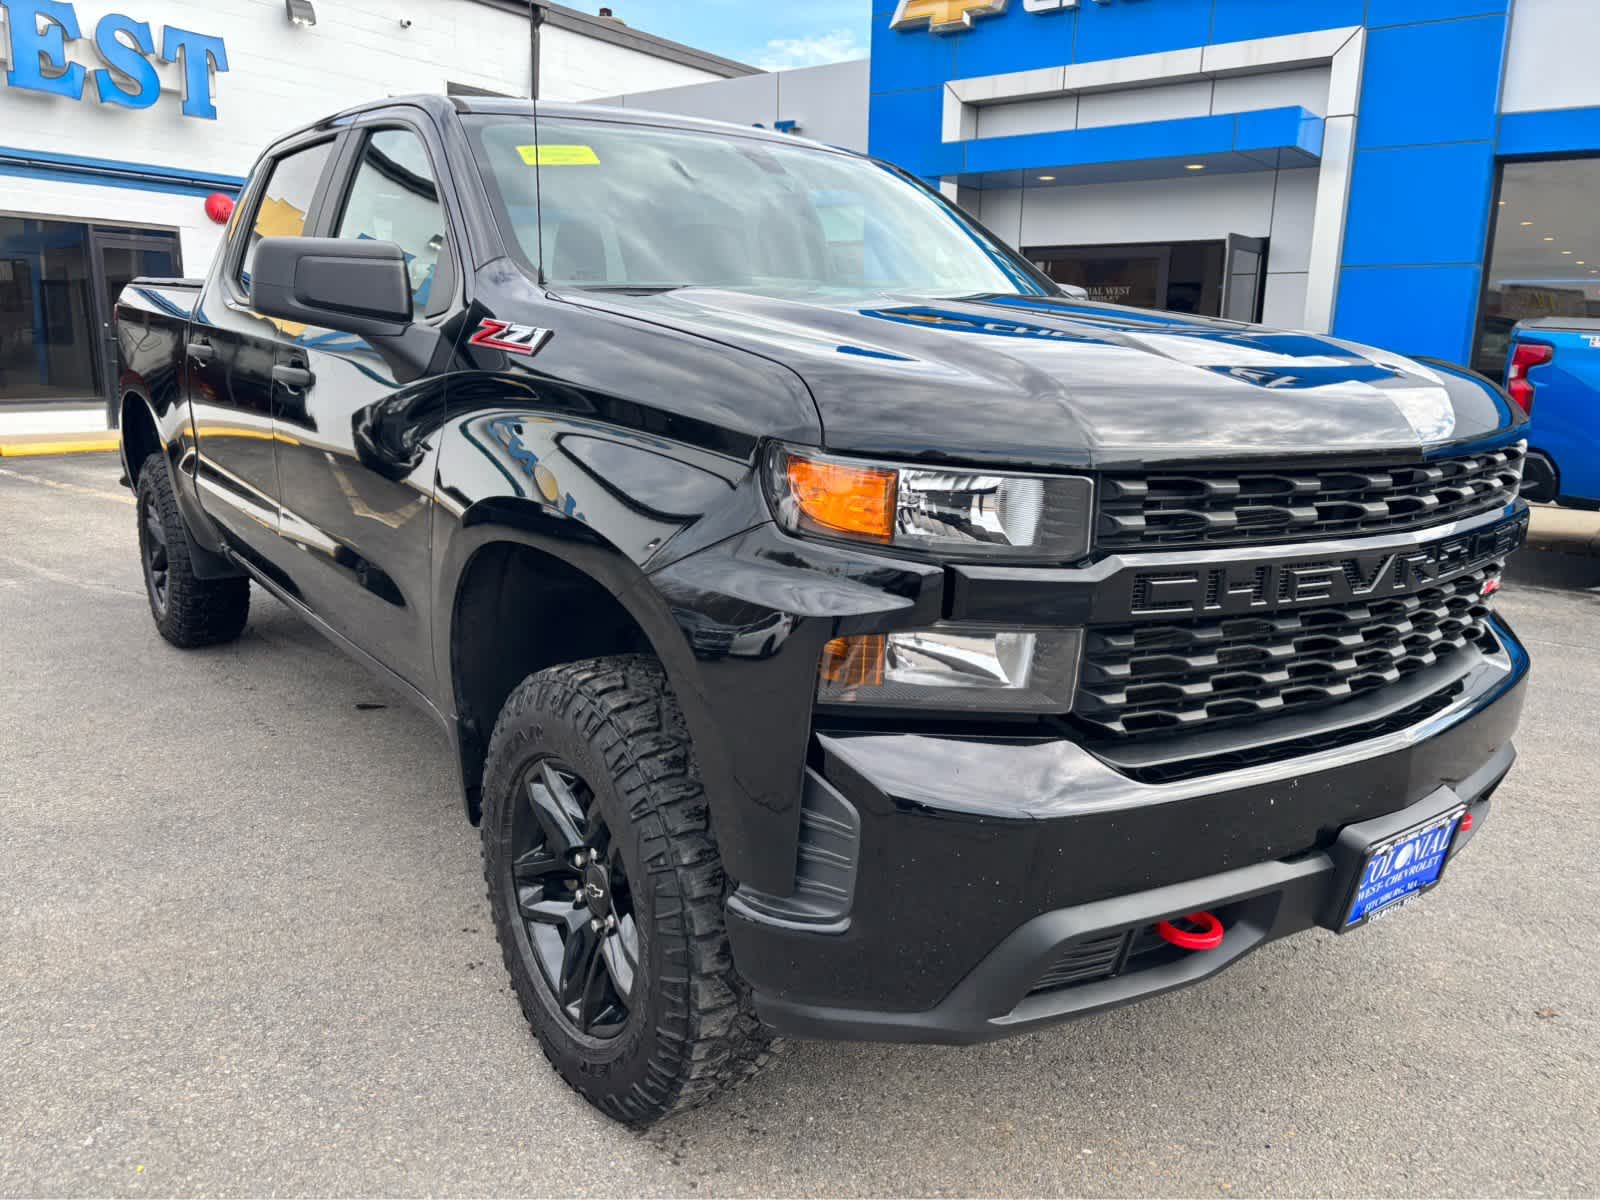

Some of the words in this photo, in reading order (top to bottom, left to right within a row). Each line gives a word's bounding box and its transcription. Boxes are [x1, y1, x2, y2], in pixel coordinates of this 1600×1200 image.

[0, 0, 229, 120] EST
[1106, 286, 1131, 296] WEST
[468, 317, 553, 356] Z71
[1131, 518, 1528, 614] CHEVROLET
